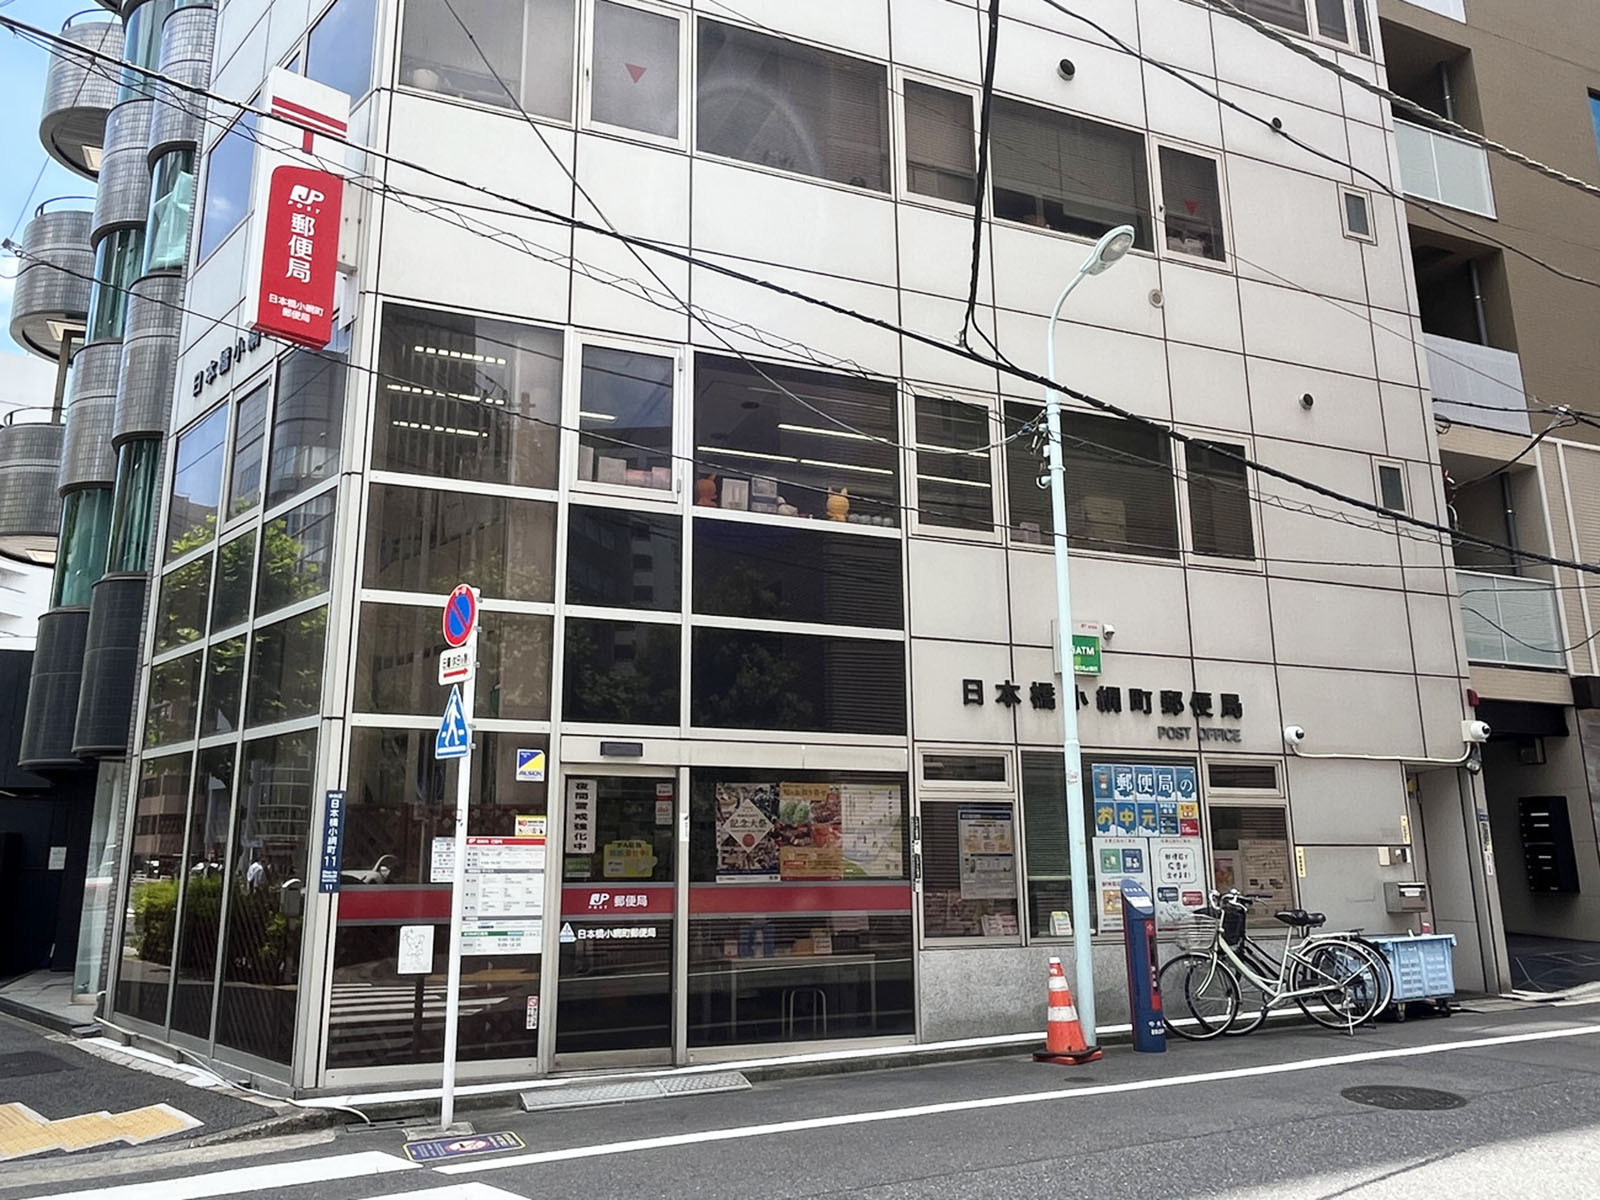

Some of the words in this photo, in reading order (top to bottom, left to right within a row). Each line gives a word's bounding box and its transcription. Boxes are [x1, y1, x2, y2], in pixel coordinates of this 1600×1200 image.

[286, 213, 316, 284] 郵便局
[1157, 726, 1192, 741] POST
[1198, 727, 1242, 743] OFFICE
[1116, 773, 1193, 795] 郵便局の
[573, 782, 589, 850] 夜間警戒強化中
[1097, 807, 1156, 826] お中元
[324, 855, 337, 867] 11
[614, 895, 648, 908] 郵便局
